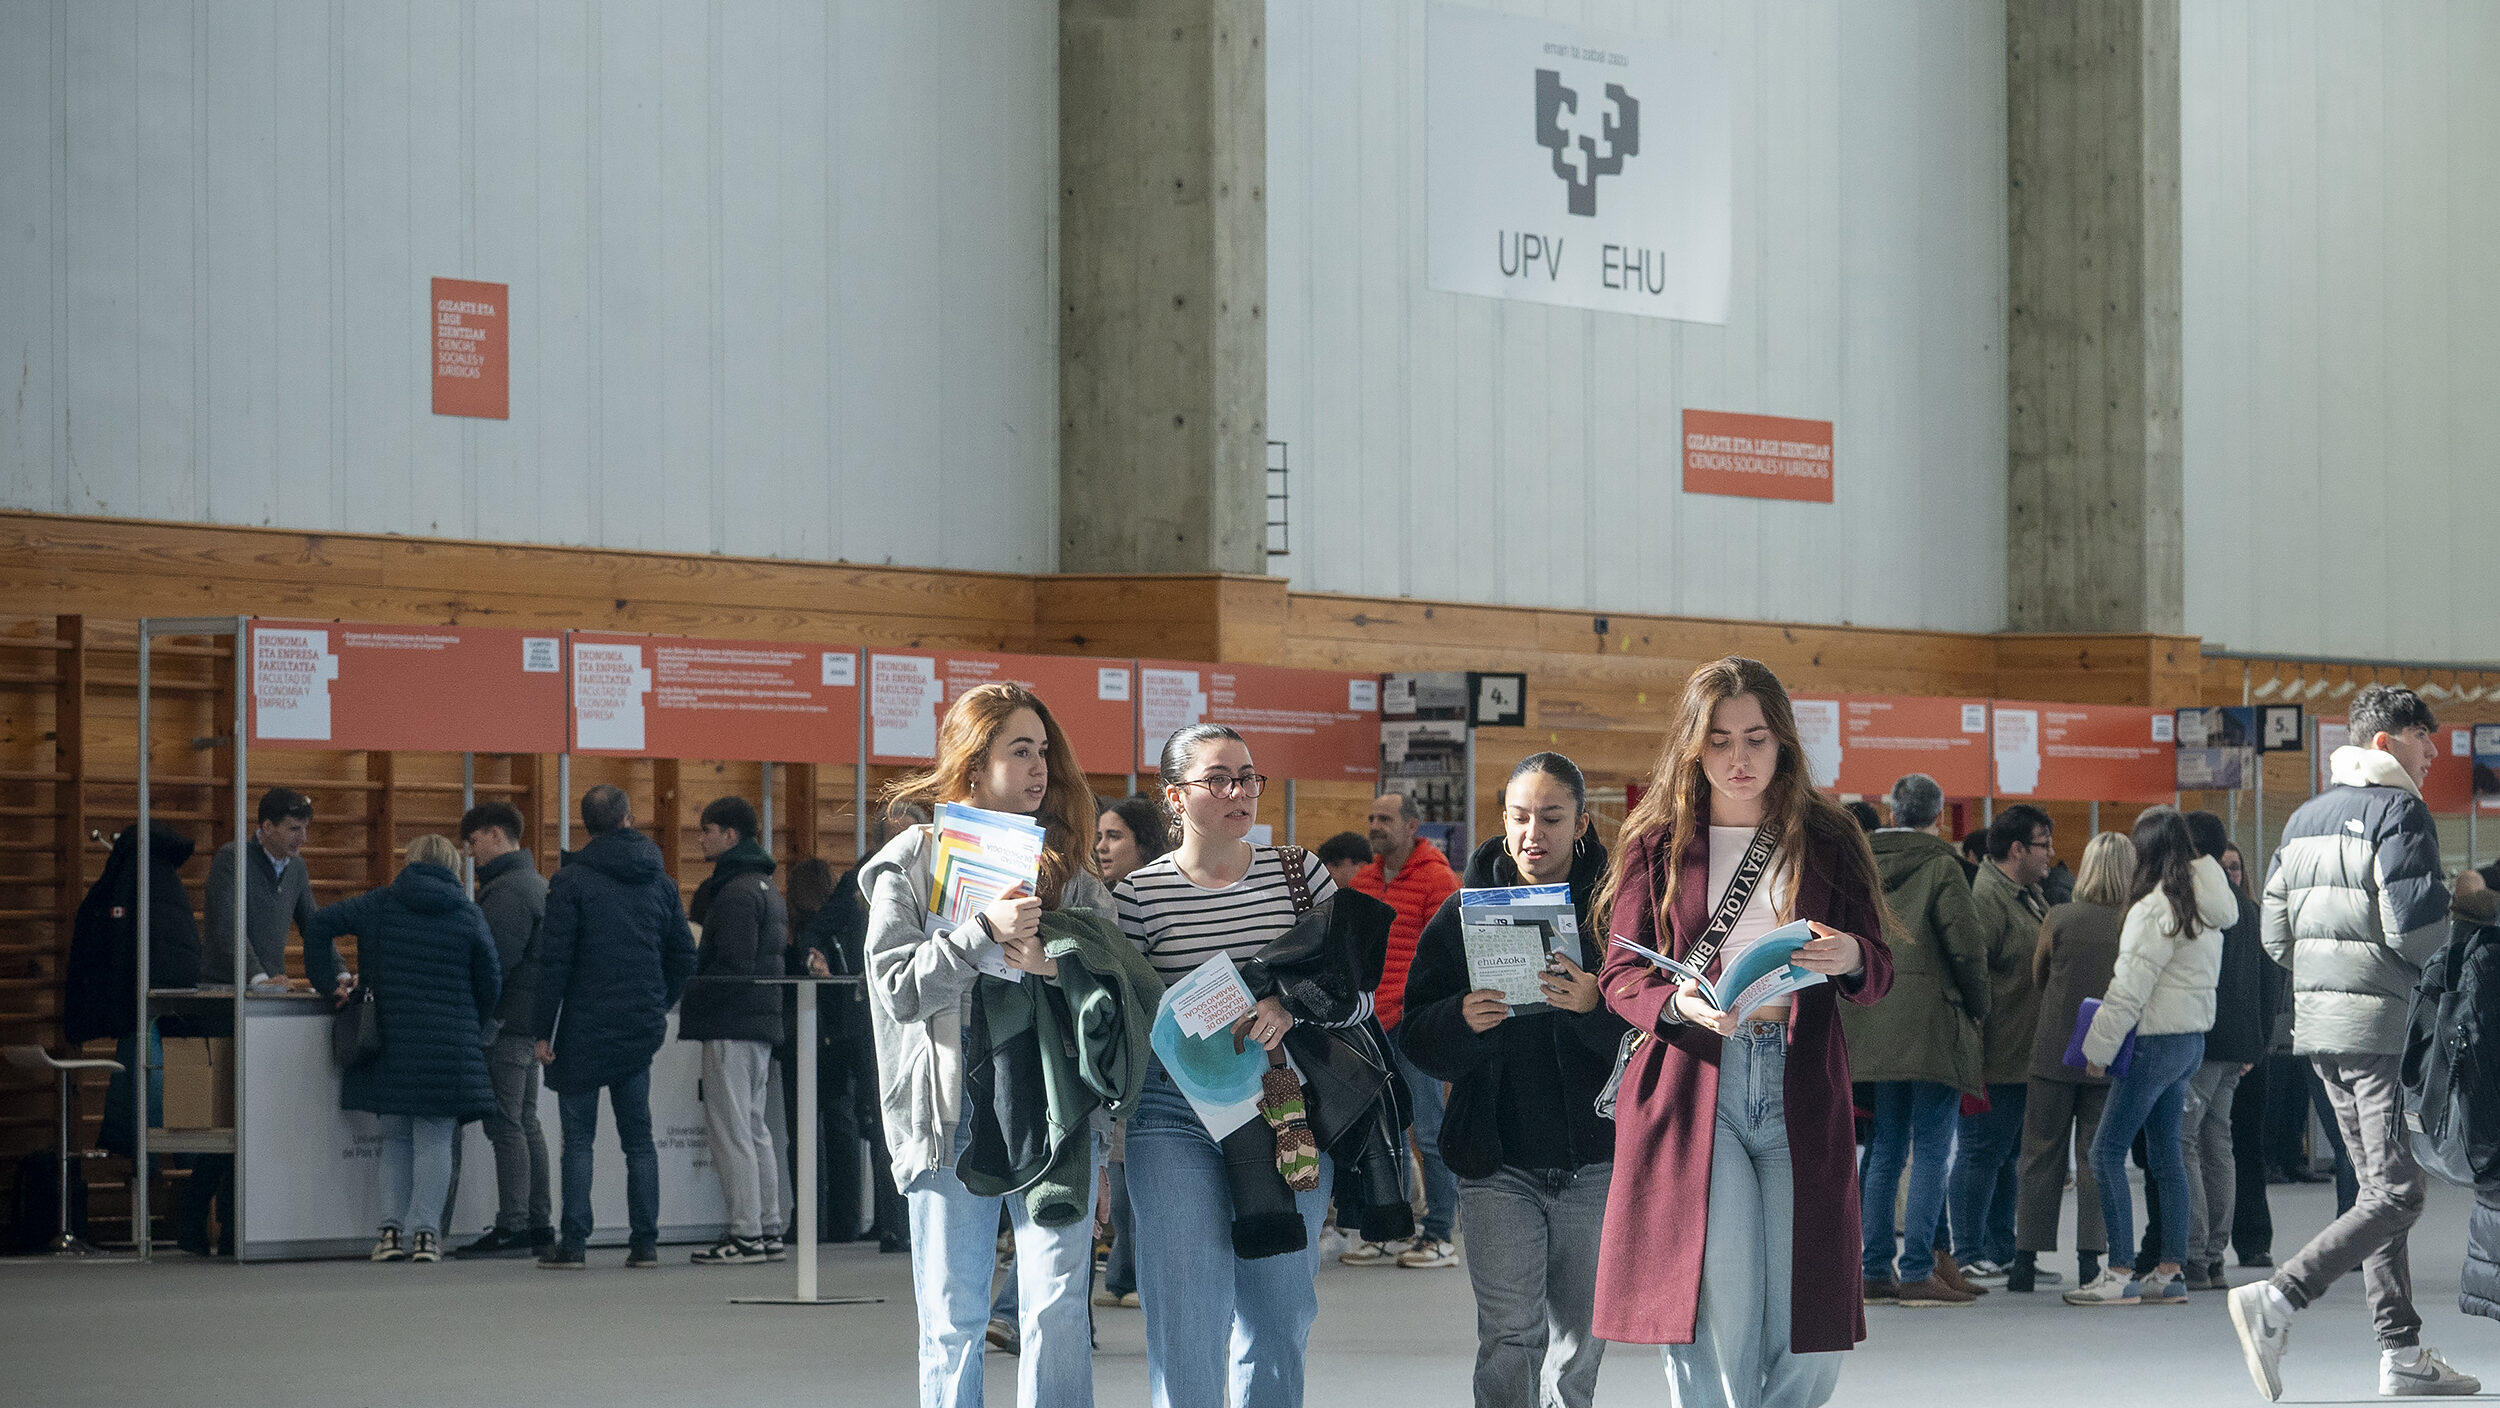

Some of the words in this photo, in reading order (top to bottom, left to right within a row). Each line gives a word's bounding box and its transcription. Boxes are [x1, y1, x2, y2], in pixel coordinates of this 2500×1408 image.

[1499, 230, 1564, 282] UPV
[1602, 243, 1665, 295] EHU
[258, 635, 308, 648] EKONOMIA
[258, 647, 276, 660] ETA
[578, 649, 624, 662] EKONOMIA
[258, 659, 317, 673] FAKULTATEA
[578, 661, 594, 674] ETA
[1491, 687, 1509, 706] 4.
[2275, 717, 2289, 733] 5.
[1710, 886, 1748, 933] LOLA
[1477, 956, 1527, 967] ehuAzoka
[1206, 983, 1238, 1005] TRABAJO
[1182, 1001, 1208, 1020] SOCIAL
[1201, 989, 1241, 1017] LABORALES
[1203, 995, 1245, 1024] RELACIONES
[1215, 1001, 1249, 1025] FACULTAD
[1205, 1023, 1217, 1032] DE
